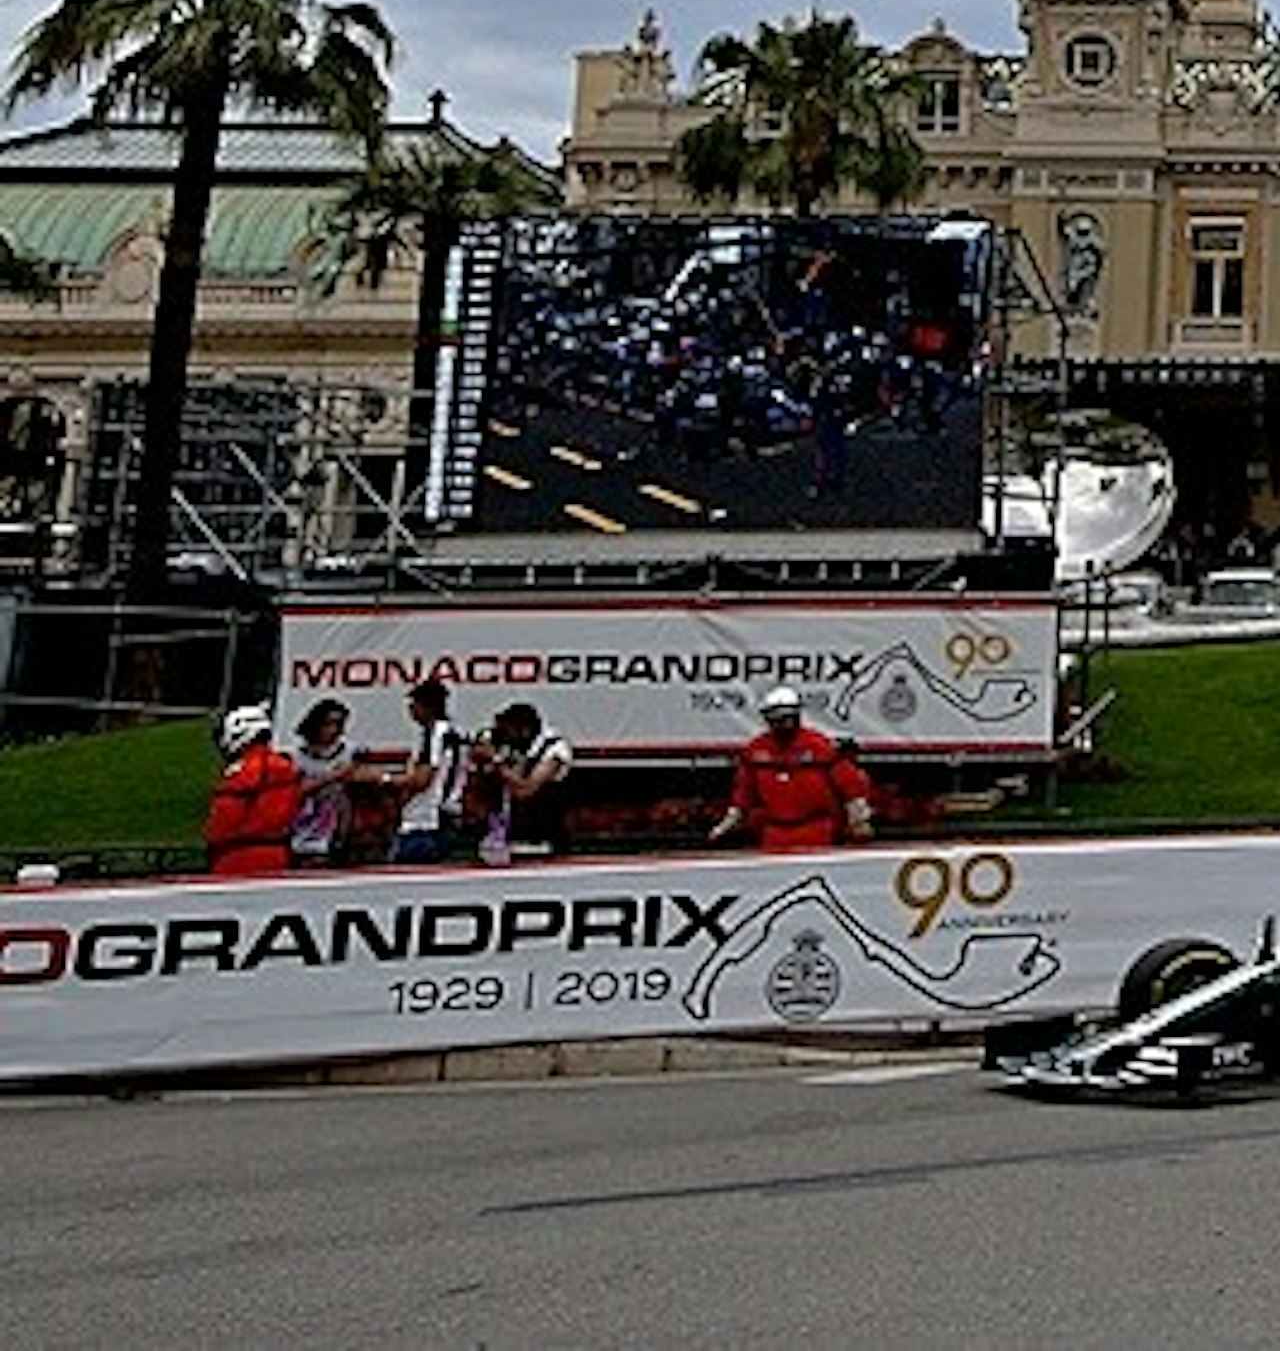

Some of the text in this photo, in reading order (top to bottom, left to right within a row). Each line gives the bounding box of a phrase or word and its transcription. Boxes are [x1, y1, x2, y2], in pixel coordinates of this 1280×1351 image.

[946, 634, 1011, 680] 90
[896, 853, 1014, 937] 90
[388, 975, 505, 1014] 1929
[555, 968, 672, 1005] 2019
